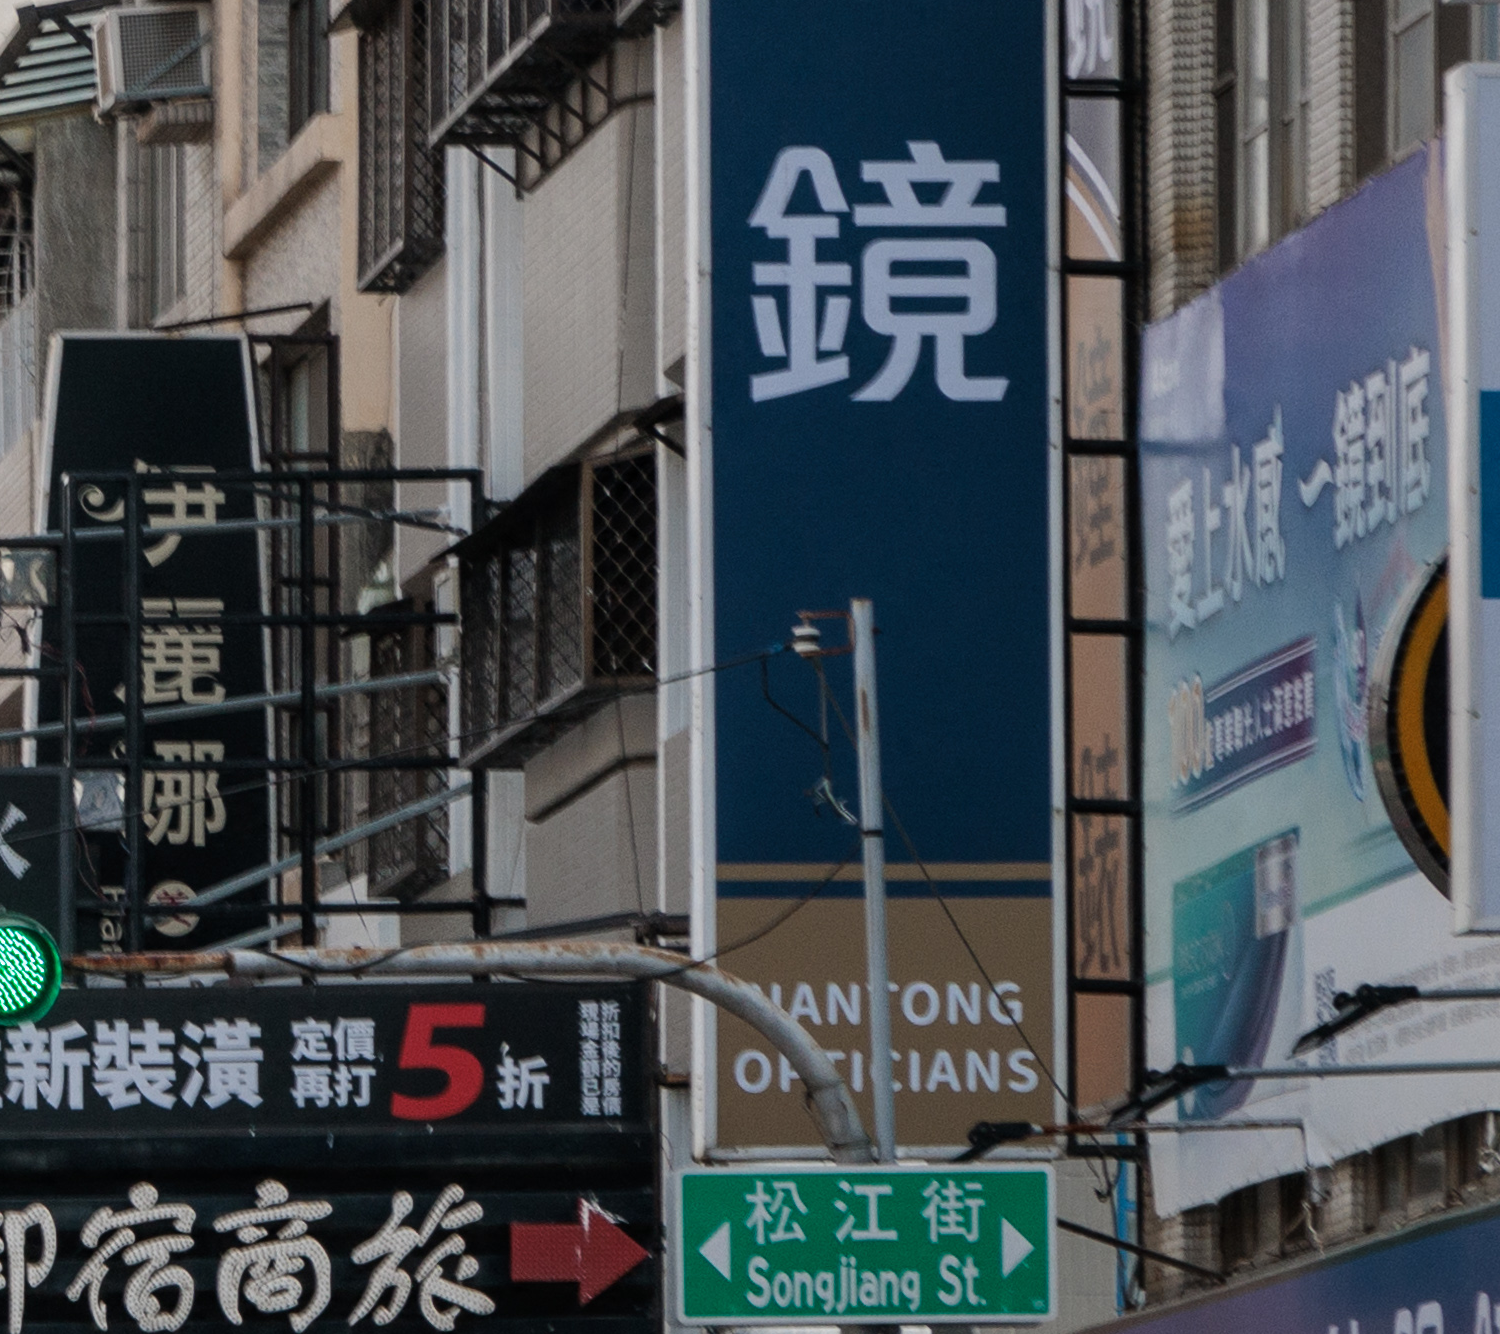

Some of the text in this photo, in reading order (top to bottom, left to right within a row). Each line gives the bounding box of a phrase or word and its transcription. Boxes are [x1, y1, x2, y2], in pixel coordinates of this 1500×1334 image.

[748, 981, 1024, 1026] ANONG
[745, 1180, 986, 1244] 松江街
[745, 1254, 987, 1314] Songjiang St.
